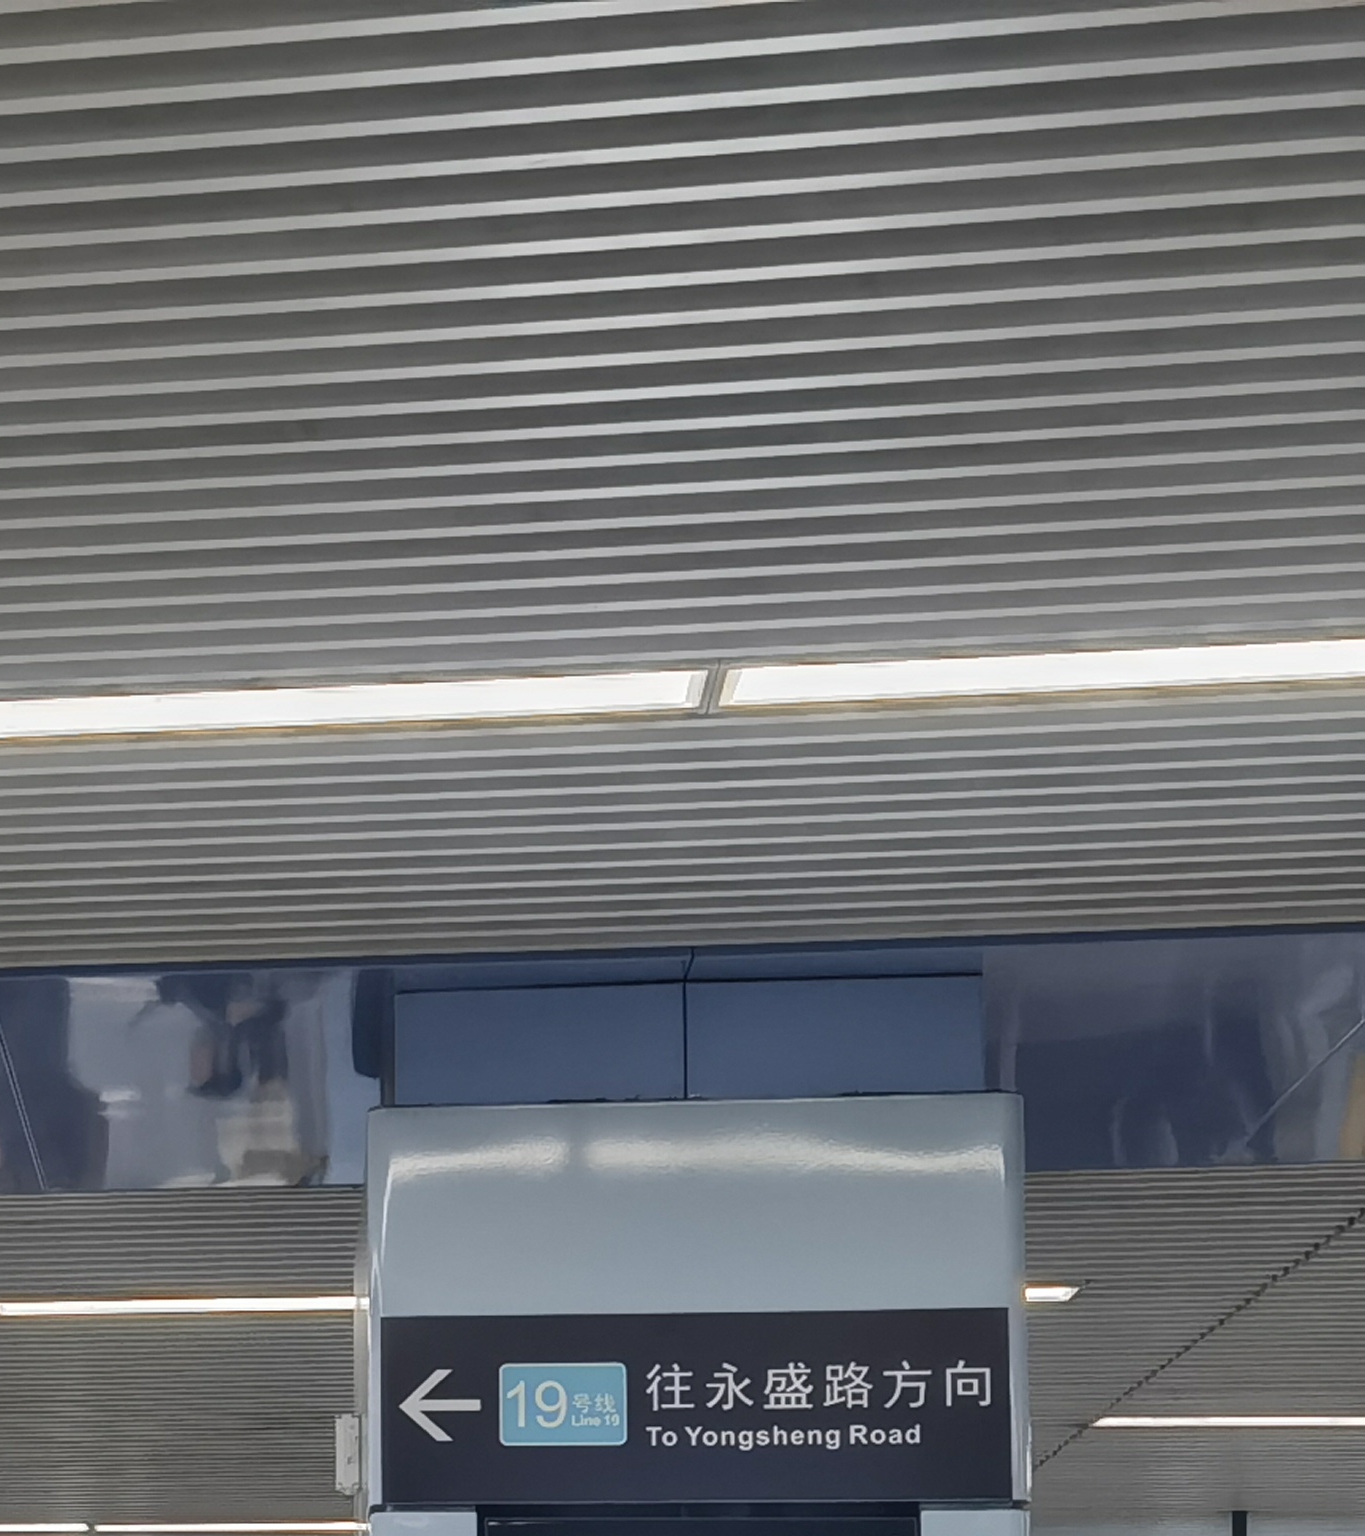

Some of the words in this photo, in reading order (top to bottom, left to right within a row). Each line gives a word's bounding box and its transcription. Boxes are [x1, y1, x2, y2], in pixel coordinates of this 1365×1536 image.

[645, 1360, 993, 1411] 往永盛路方向
[571, 1413, 602, 1427] Line
[604, 1413, 621, 1427] 19
[646, 1425, 678, 1447] To
[684, 1425, 842, 1451] Yongsheng
[849, 1424, 922, 1447] Road
